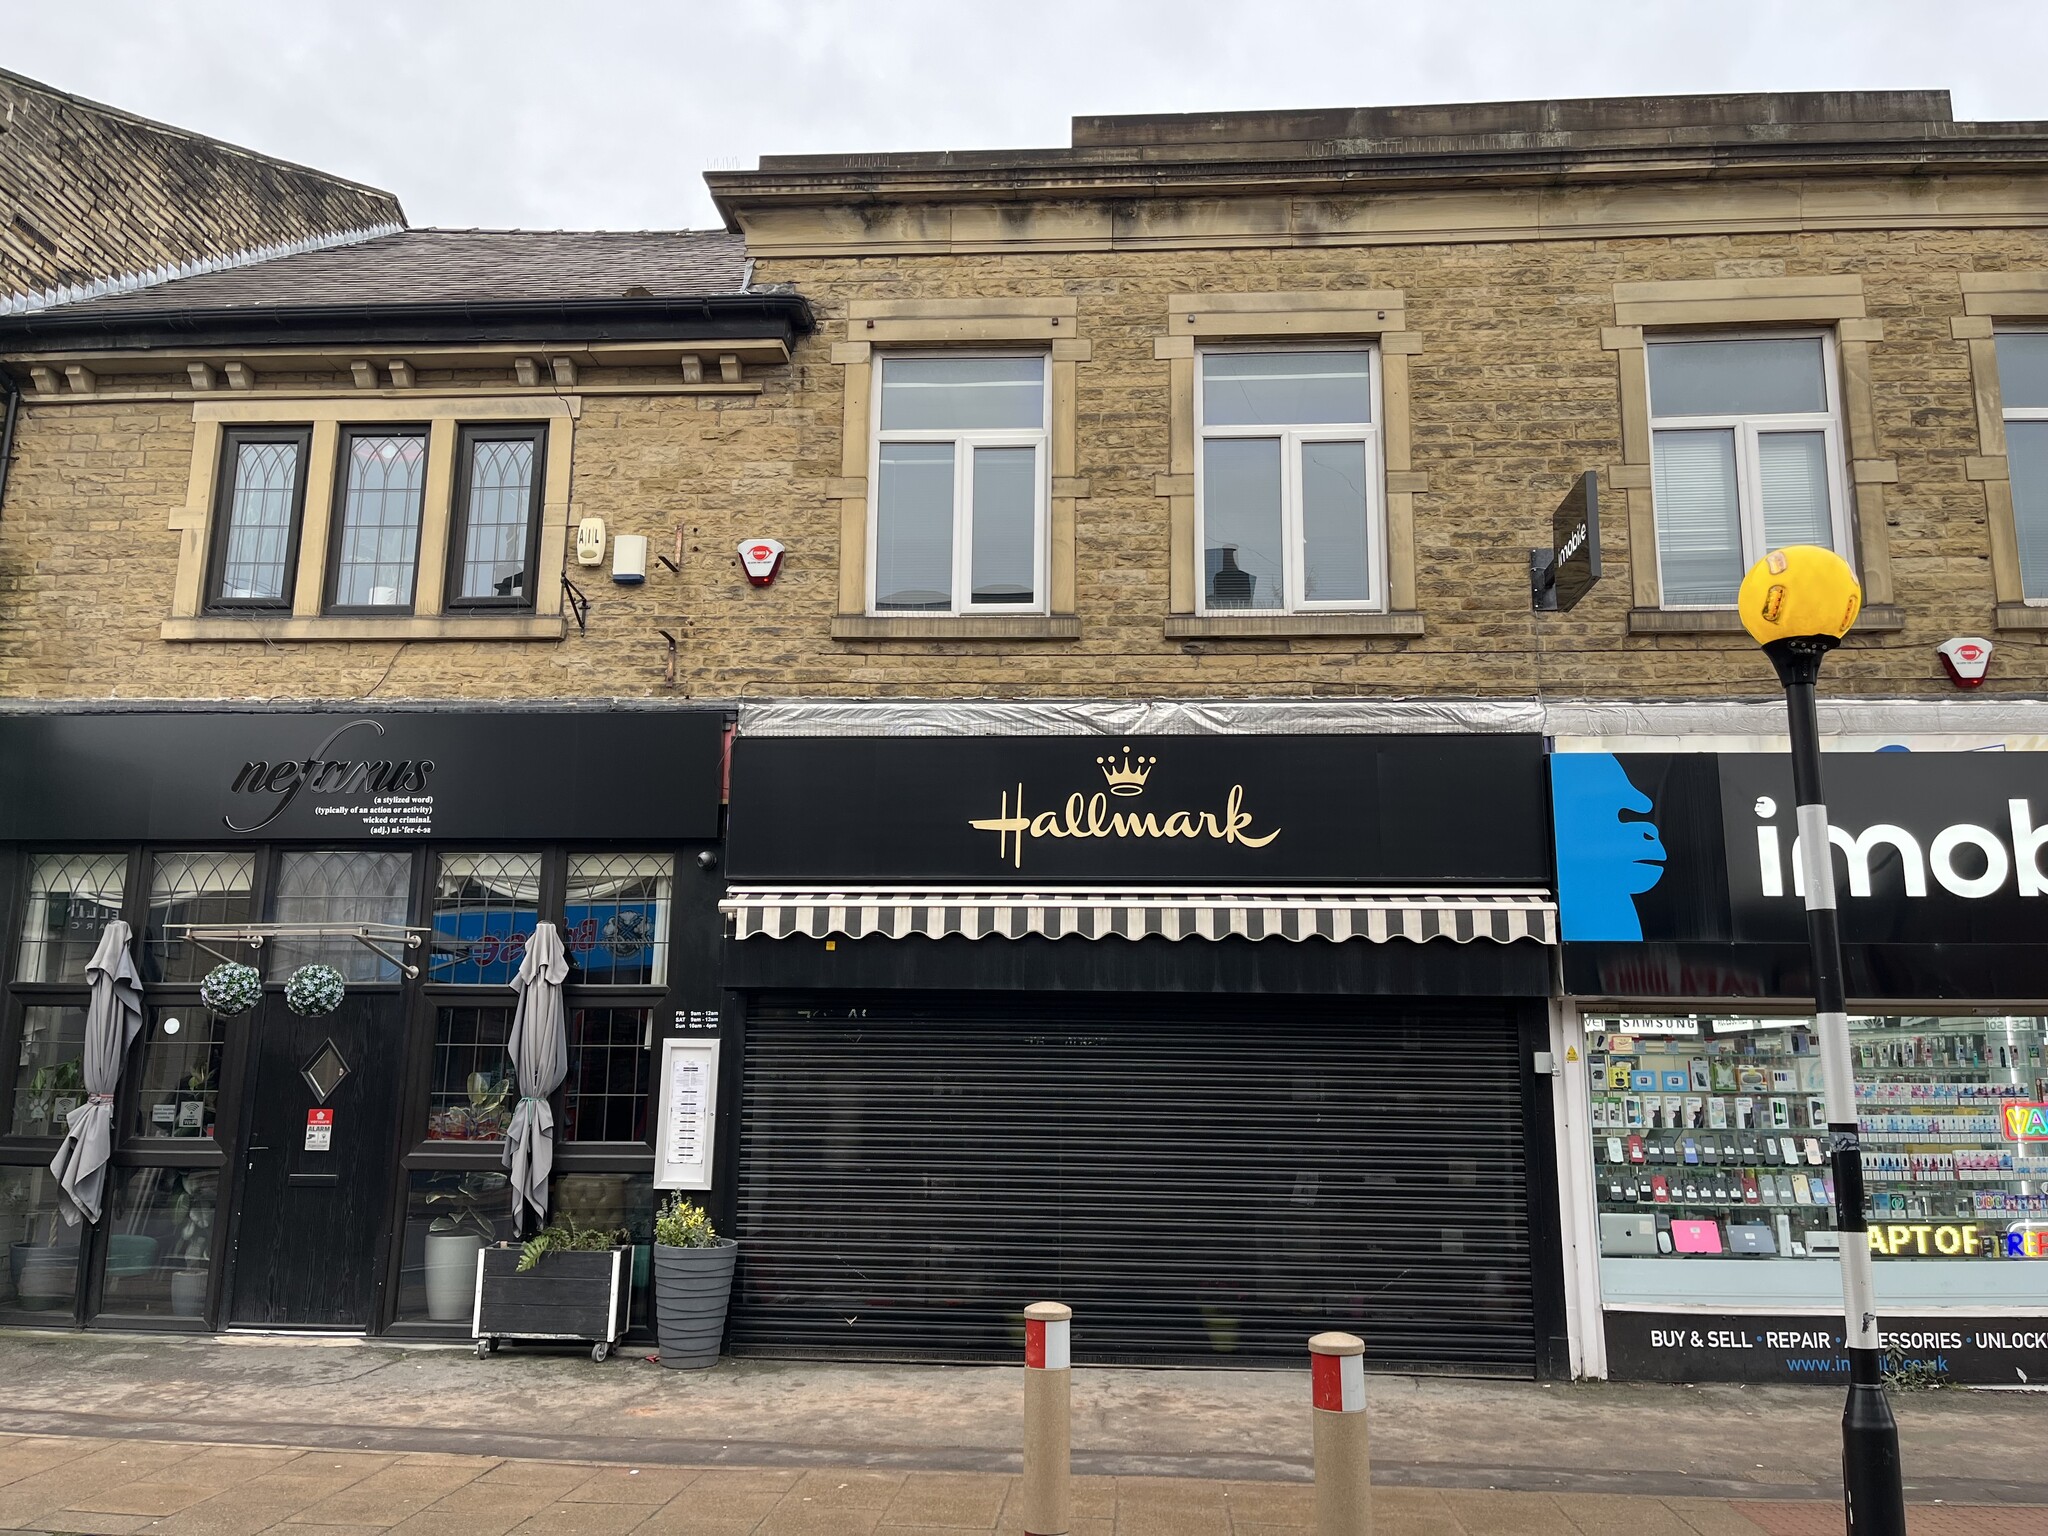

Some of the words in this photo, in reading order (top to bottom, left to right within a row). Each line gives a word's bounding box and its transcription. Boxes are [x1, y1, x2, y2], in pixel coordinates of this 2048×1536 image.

[1558, 522, 1587, 568] imobile
[382, 796, 410, 805] stylized
[411, 796, 434, 805] word)
[315, 806, 349, 815] (typically
[350, 806, 359, 814] of
[369, 806, 392, 814] action
[402, 806, 433, 815] activity)
[362, 816, 388, 824] wicked
[399, 816, 432, 824] criminal.
[968, 782, 1282, 869] Hallmark
[2006, 1108, 2048, 1135] VA
[1650, 1330, 1686, 1347] BUY
[1690, 1331, 1704, 1347] &
[1707, 1331, 1753, 1348] SELL
[1766, 1331, 1831, 1348] REPAIR
[1844, 1332, 1962, 1349] ESSORIES
[1975, 1332, 2048, 1349] UNLOCK
